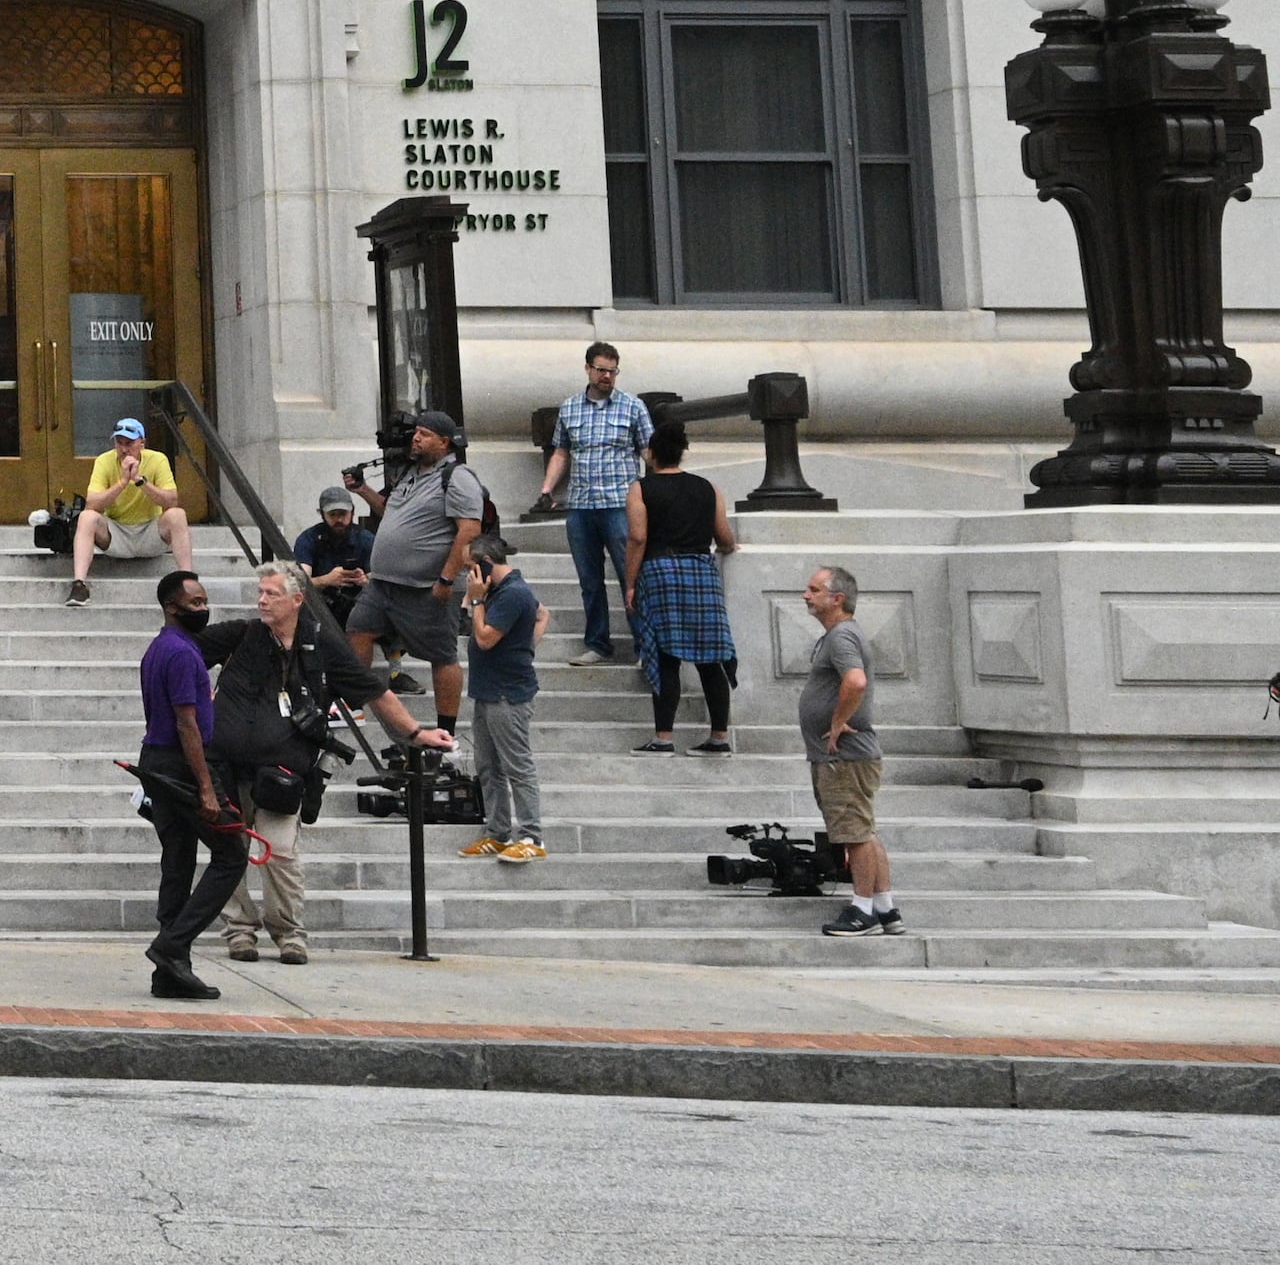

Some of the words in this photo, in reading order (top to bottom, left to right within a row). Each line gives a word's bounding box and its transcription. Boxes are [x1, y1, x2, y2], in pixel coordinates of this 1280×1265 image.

[401, 0, 469, 90] J2
[428, 78, 474, 92] SLATON
[403, 118, 474, 139] LEWIS
[485, 118, 505, 139] R.
[404, 144, 493, 164] SLATON
[406, 169, 561, 190] COURTHOUSE
[452, 213, 516, 231] PRYOR
[525, 213, 549, 230] ST
[90, 322, 118, 341] EXIT
[120, 322, 154, 341] ONLY
